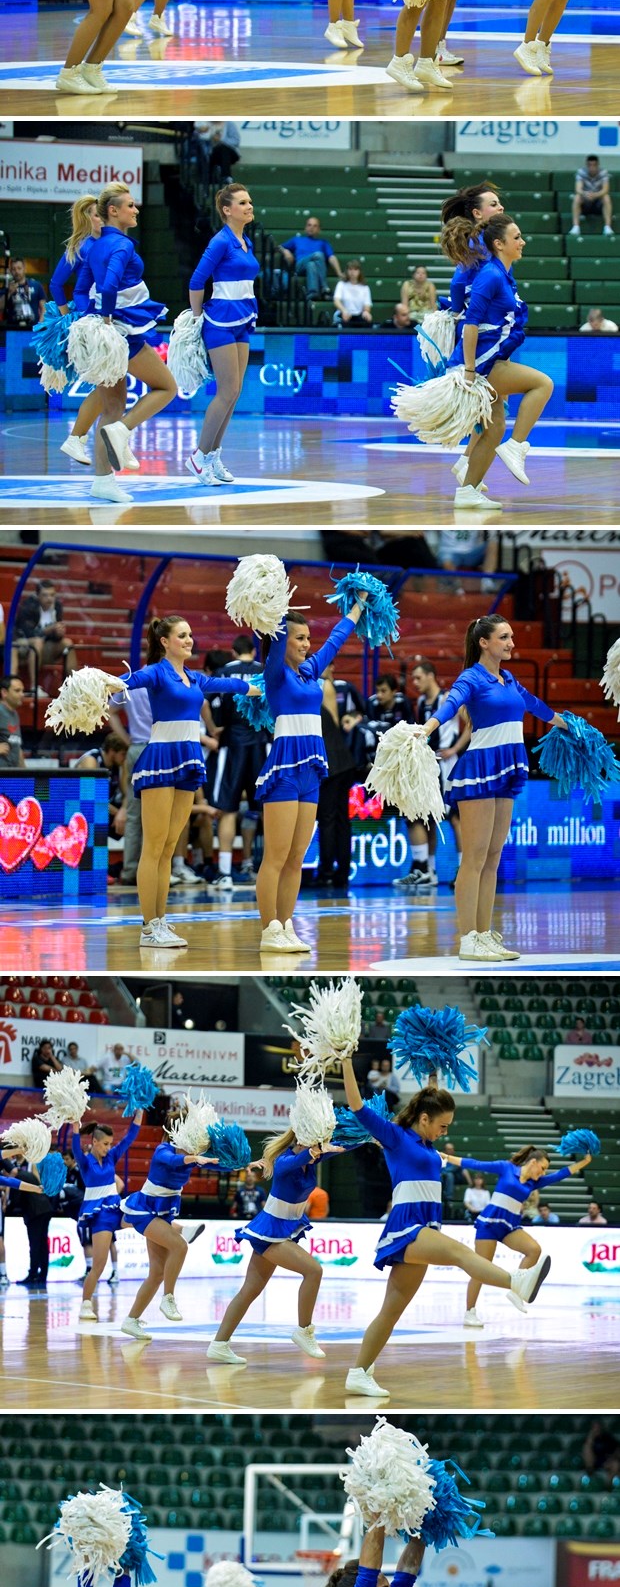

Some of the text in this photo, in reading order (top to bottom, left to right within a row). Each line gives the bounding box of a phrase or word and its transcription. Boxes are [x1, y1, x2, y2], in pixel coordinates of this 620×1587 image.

[459, 121, 559, 144] Zagreb
[57, 163, 141, 184] Medikol
[259, 363, 306, 392] City
[547, 816, 606, 846] million
[21, 1035, 66, 1048] NARDNI
[105, 1043, 151, 1057] HTEL
[152, 1060, 238, 1082] Marinero
